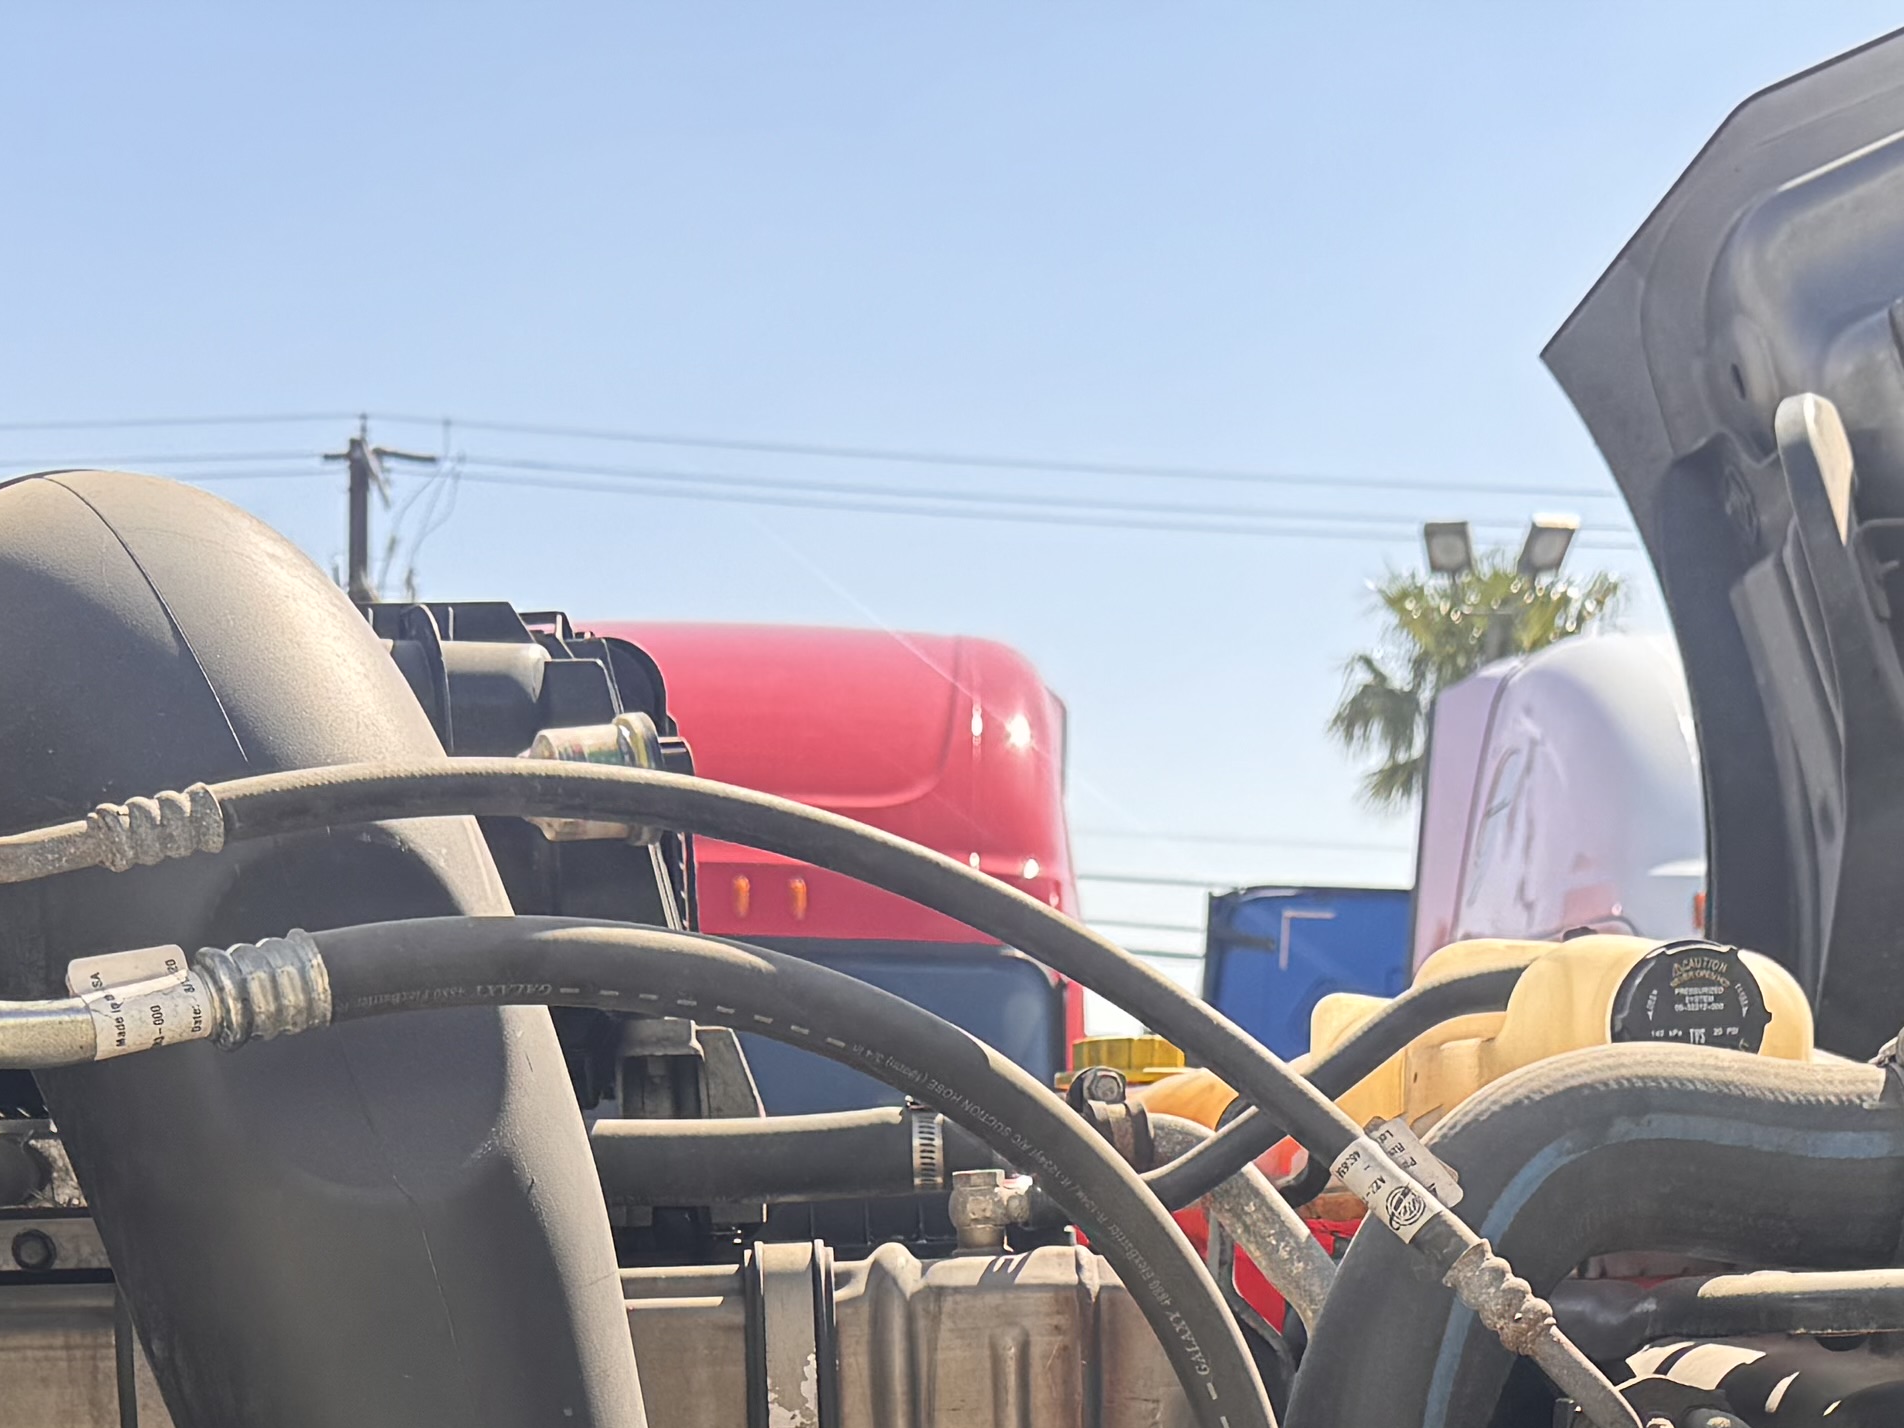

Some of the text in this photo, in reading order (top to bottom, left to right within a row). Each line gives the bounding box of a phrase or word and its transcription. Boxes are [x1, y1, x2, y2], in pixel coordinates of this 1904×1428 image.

[1681, 956, 1729, 973] CAUTION
[928, 1078, 961, 1104] HOSE
[962, 1096, 1013, 1139] SUCTION
[1166, 1310, 1210, 1377] GALAXY
